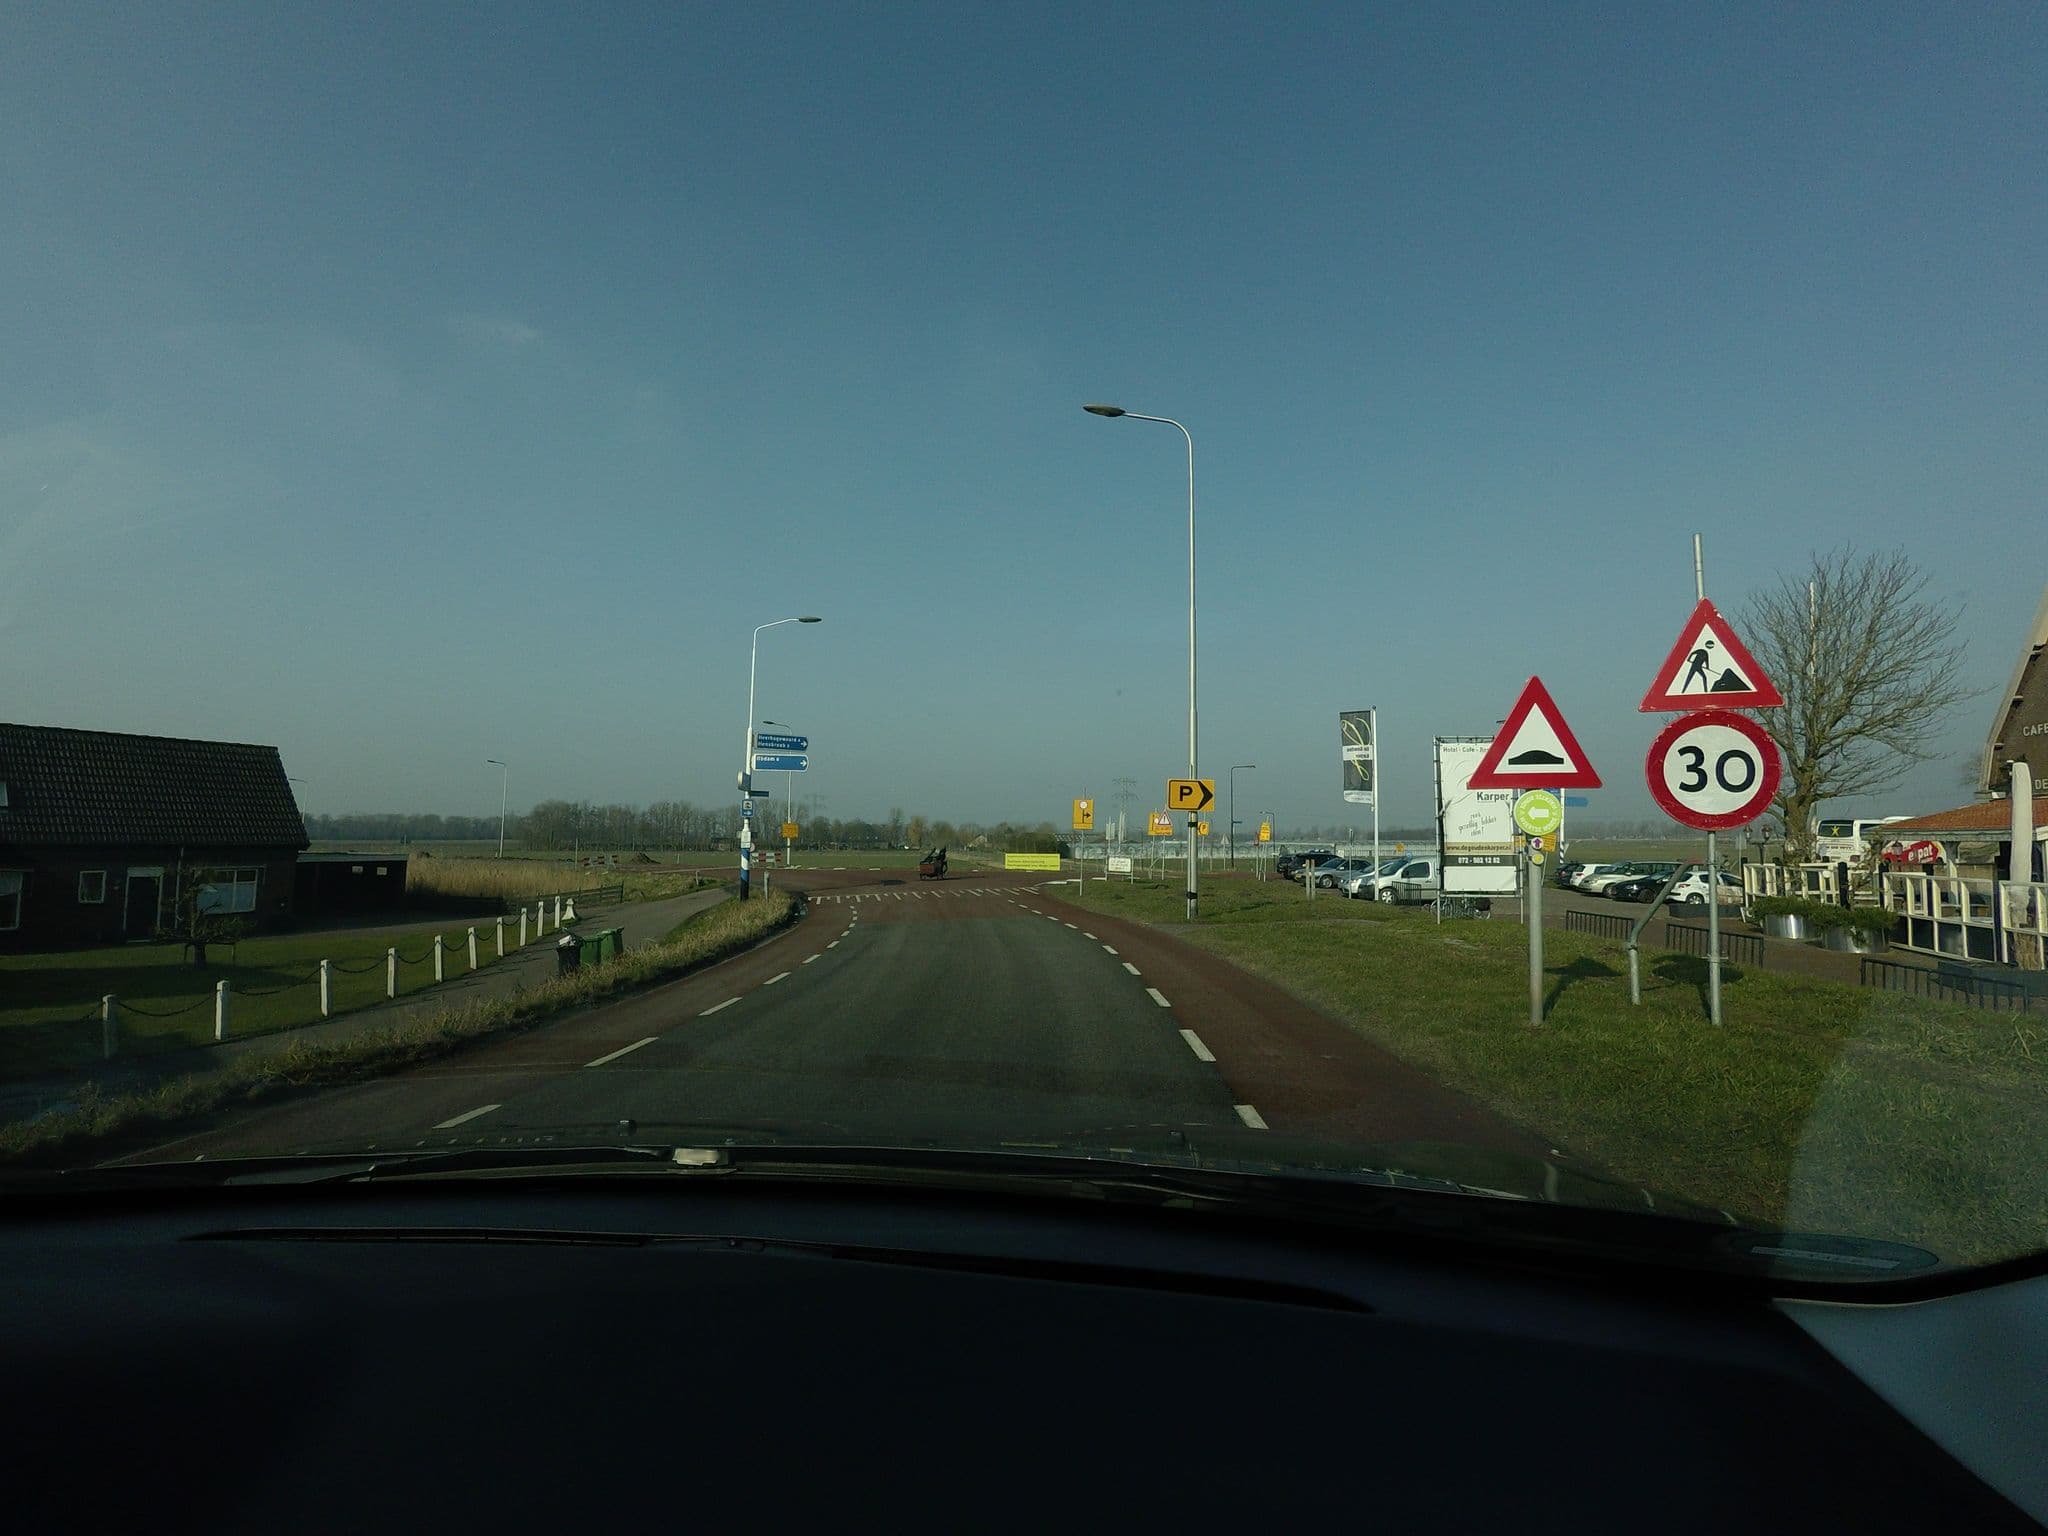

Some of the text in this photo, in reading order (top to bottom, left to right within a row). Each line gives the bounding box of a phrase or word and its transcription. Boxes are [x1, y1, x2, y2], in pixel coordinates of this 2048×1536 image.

[1677, 745, 1756, 793] 30
[1179, 785, 1193, 802] P
[1476, 791, 1510, 802] Karper
